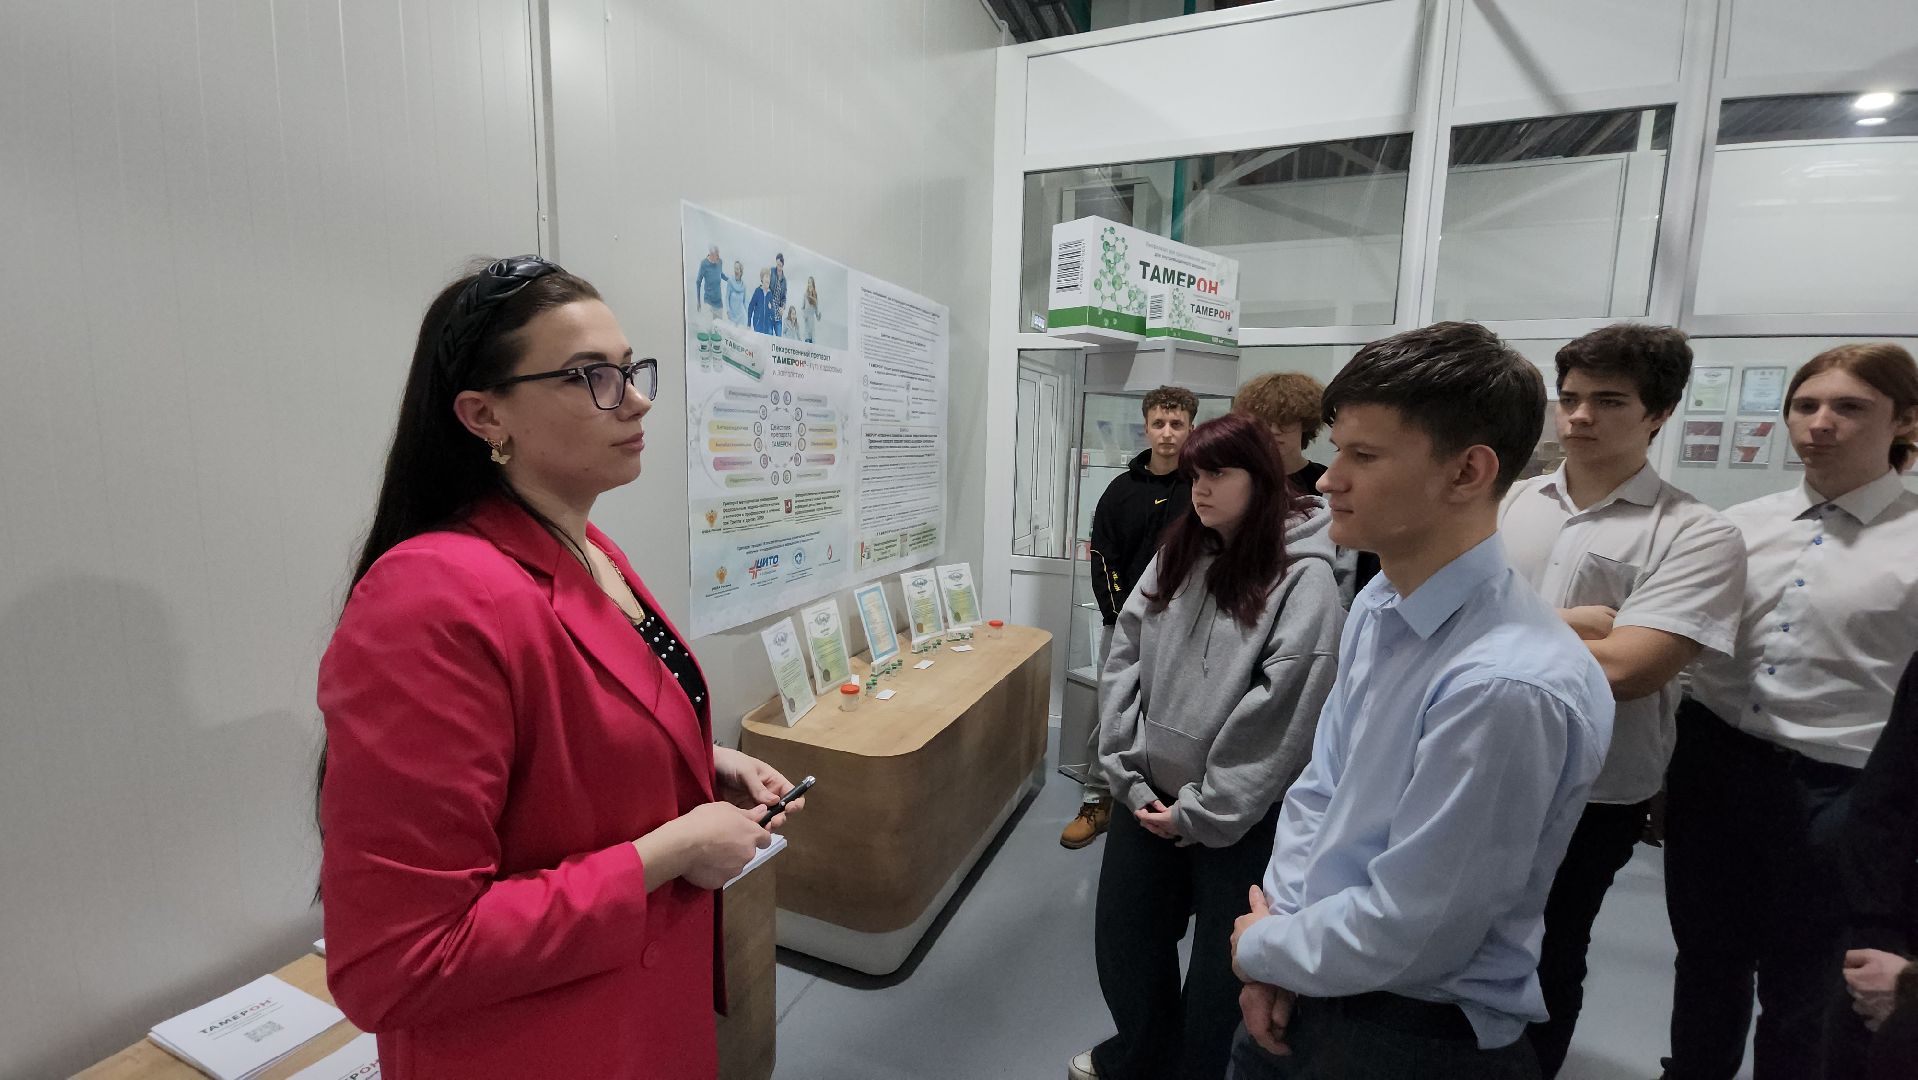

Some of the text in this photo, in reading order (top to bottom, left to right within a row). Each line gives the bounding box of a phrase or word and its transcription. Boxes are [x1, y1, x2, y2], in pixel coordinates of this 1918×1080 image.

[1139, 260, 1219, 295] ТАМЕРОН
[1190, 303, 1231, 321] ТАМЕРОН
[756, 554, 779, 568] ЦИТО
[200, 999, 271, 1033] ТАМЕРОН
